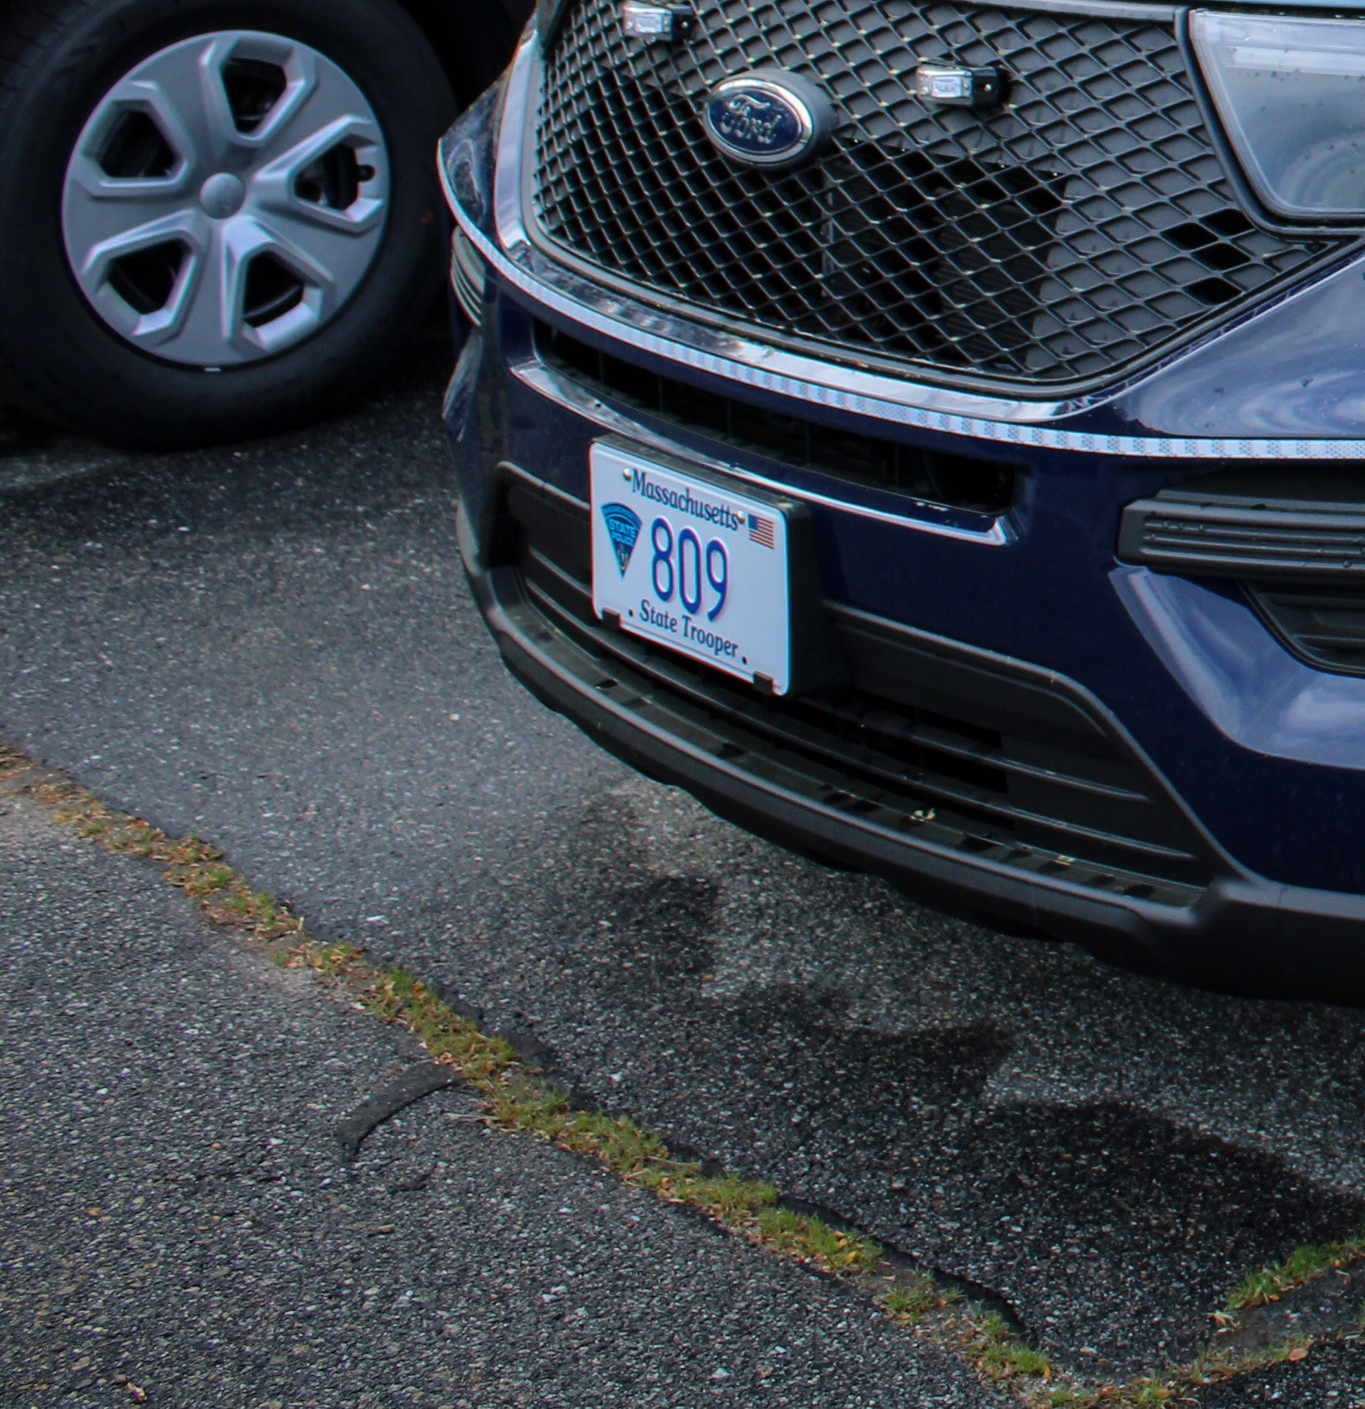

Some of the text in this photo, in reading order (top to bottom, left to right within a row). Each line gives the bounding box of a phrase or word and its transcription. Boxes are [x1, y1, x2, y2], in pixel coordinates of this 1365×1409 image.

[719, 94, 782, 144] Ford
[609, 519, 636, 538] STATE
[631, 468, 739, 531] Massachusetts
[651, 517, 729, 622] 809
[640, 599, 739, 658] State Trooper
